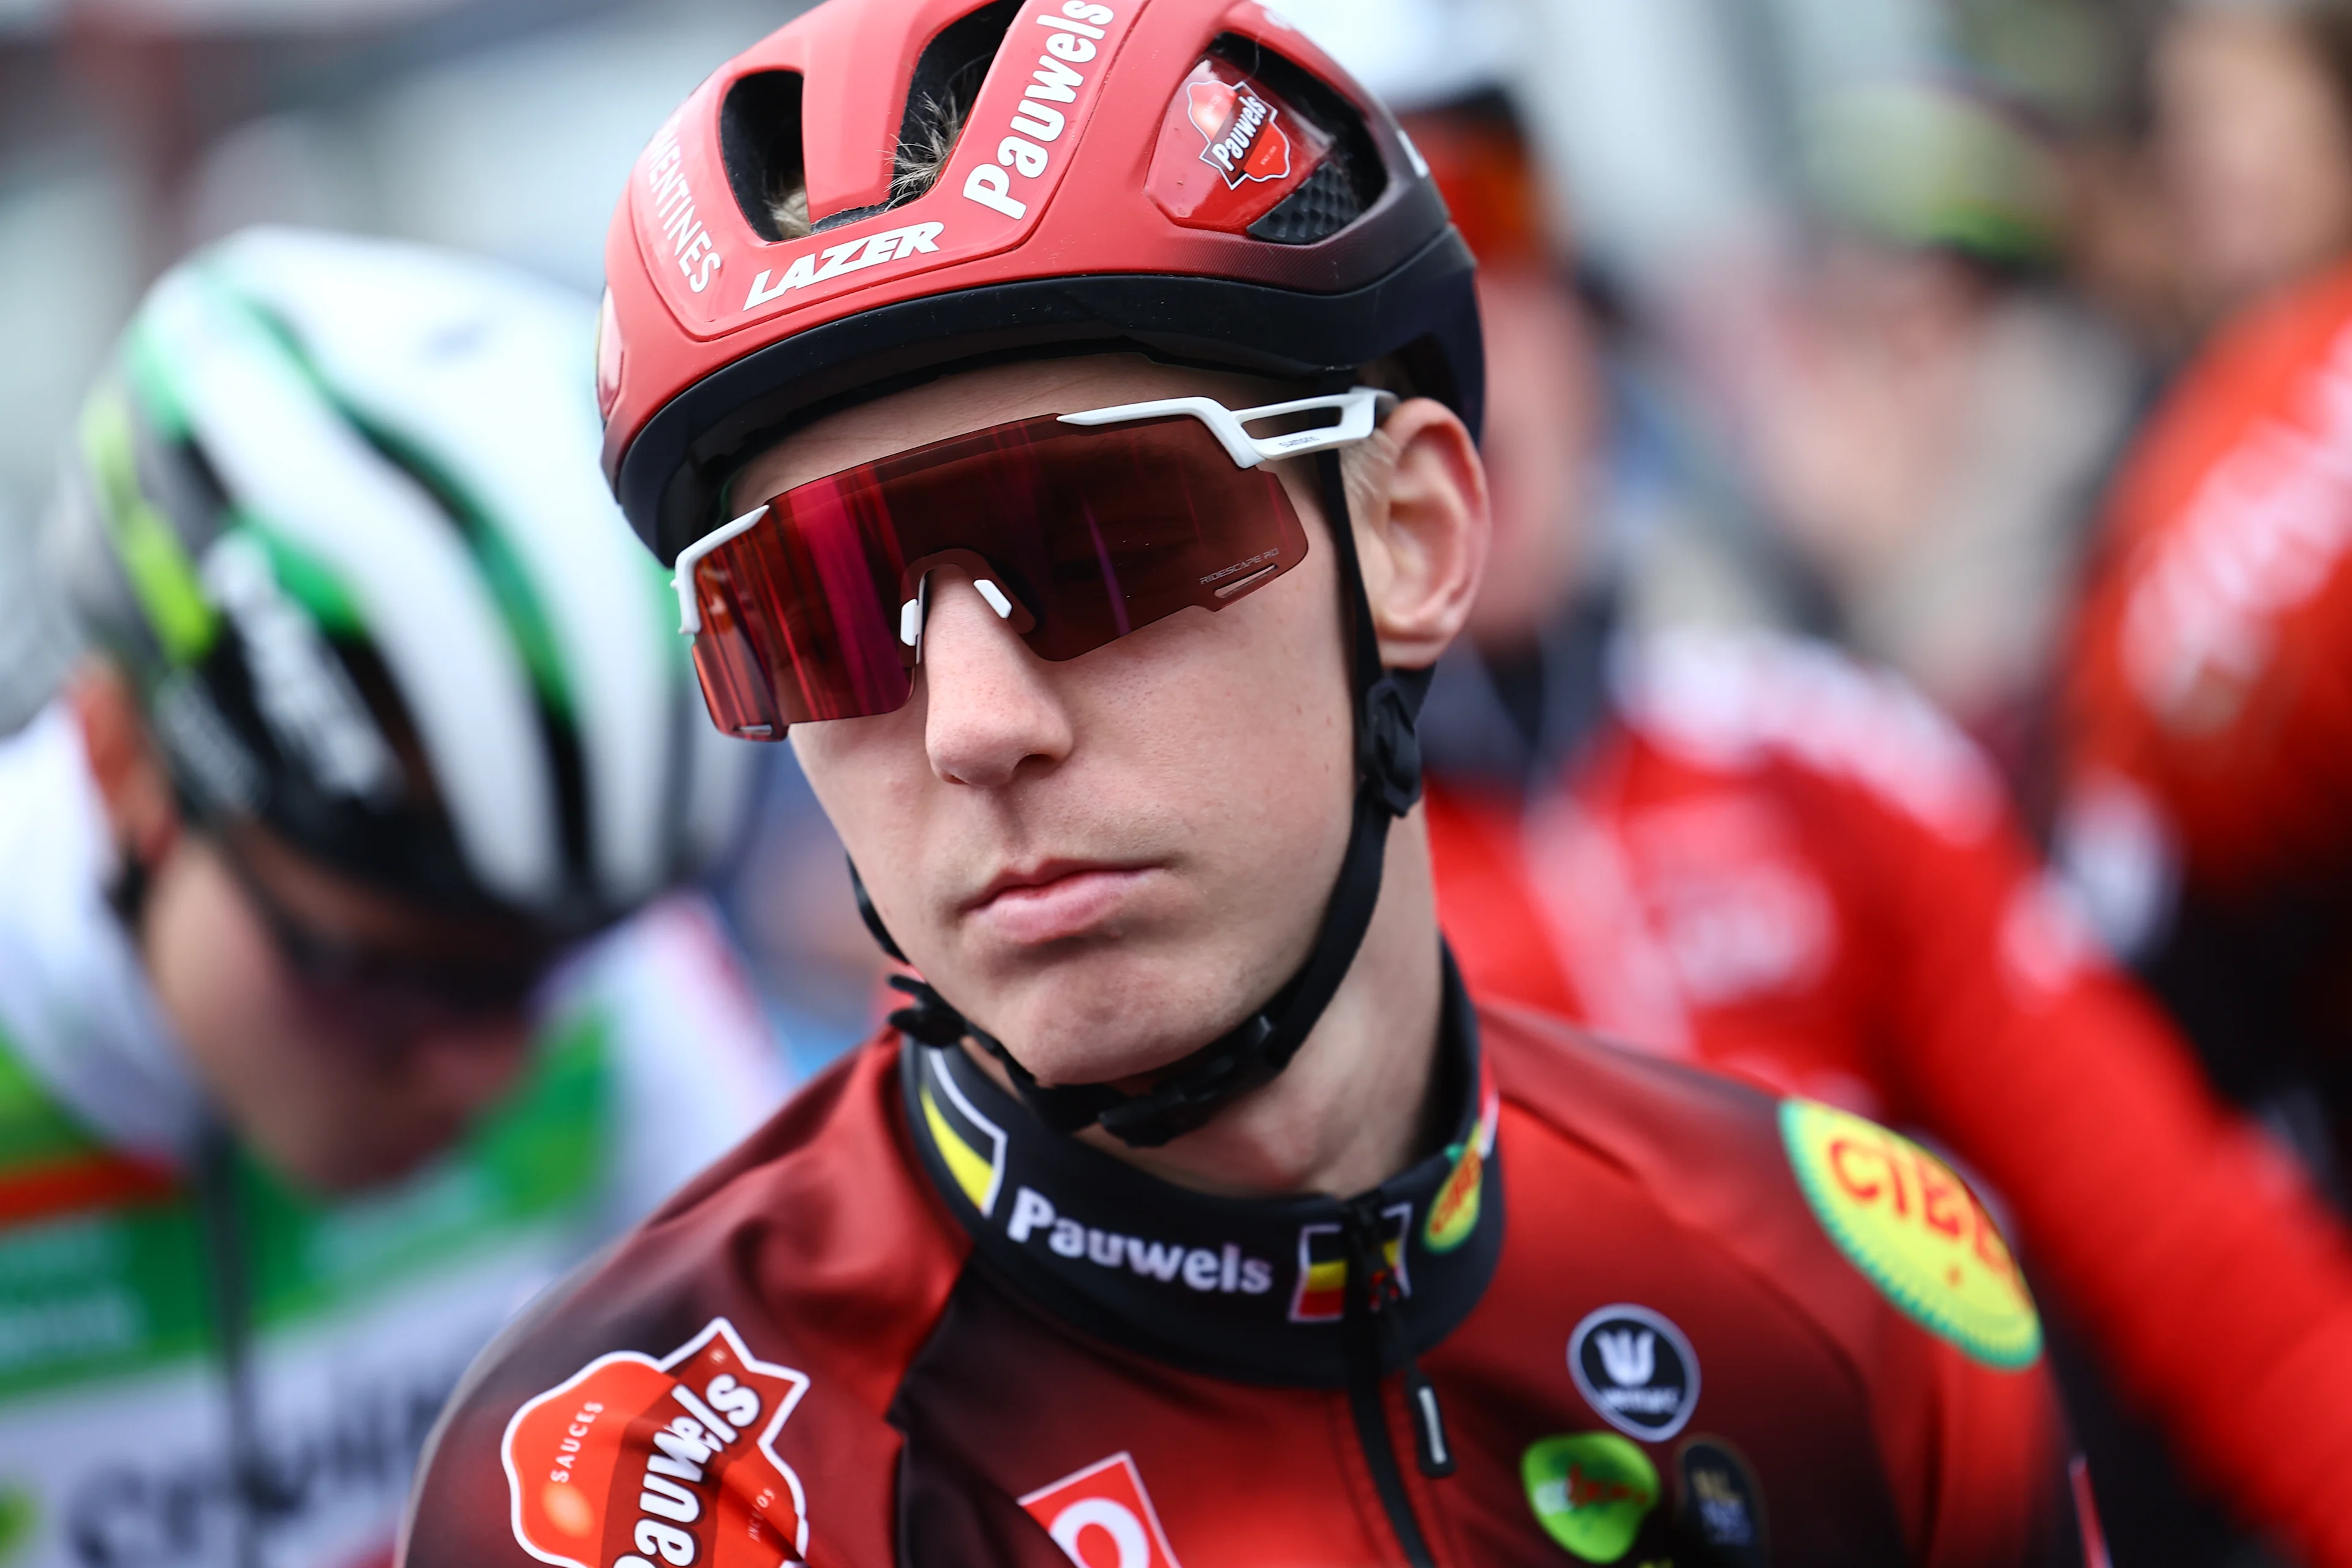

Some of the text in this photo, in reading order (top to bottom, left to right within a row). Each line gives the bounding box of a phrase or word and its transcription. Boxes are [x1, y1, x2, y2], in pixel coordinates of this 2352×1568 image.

[962, 0, 1115, 220] Pauwels
[1212, 95, 1268, 172] Pauwels
[742, 221, 945, 311] LAZER
[1199, 555, 1262, 585] RIDESCAPE
[1006, 1186, 1274, 1295] Pauwels
[551, 1401, 604, 1483] SAUCES
[611, 1373, 761, 1568] auwels
